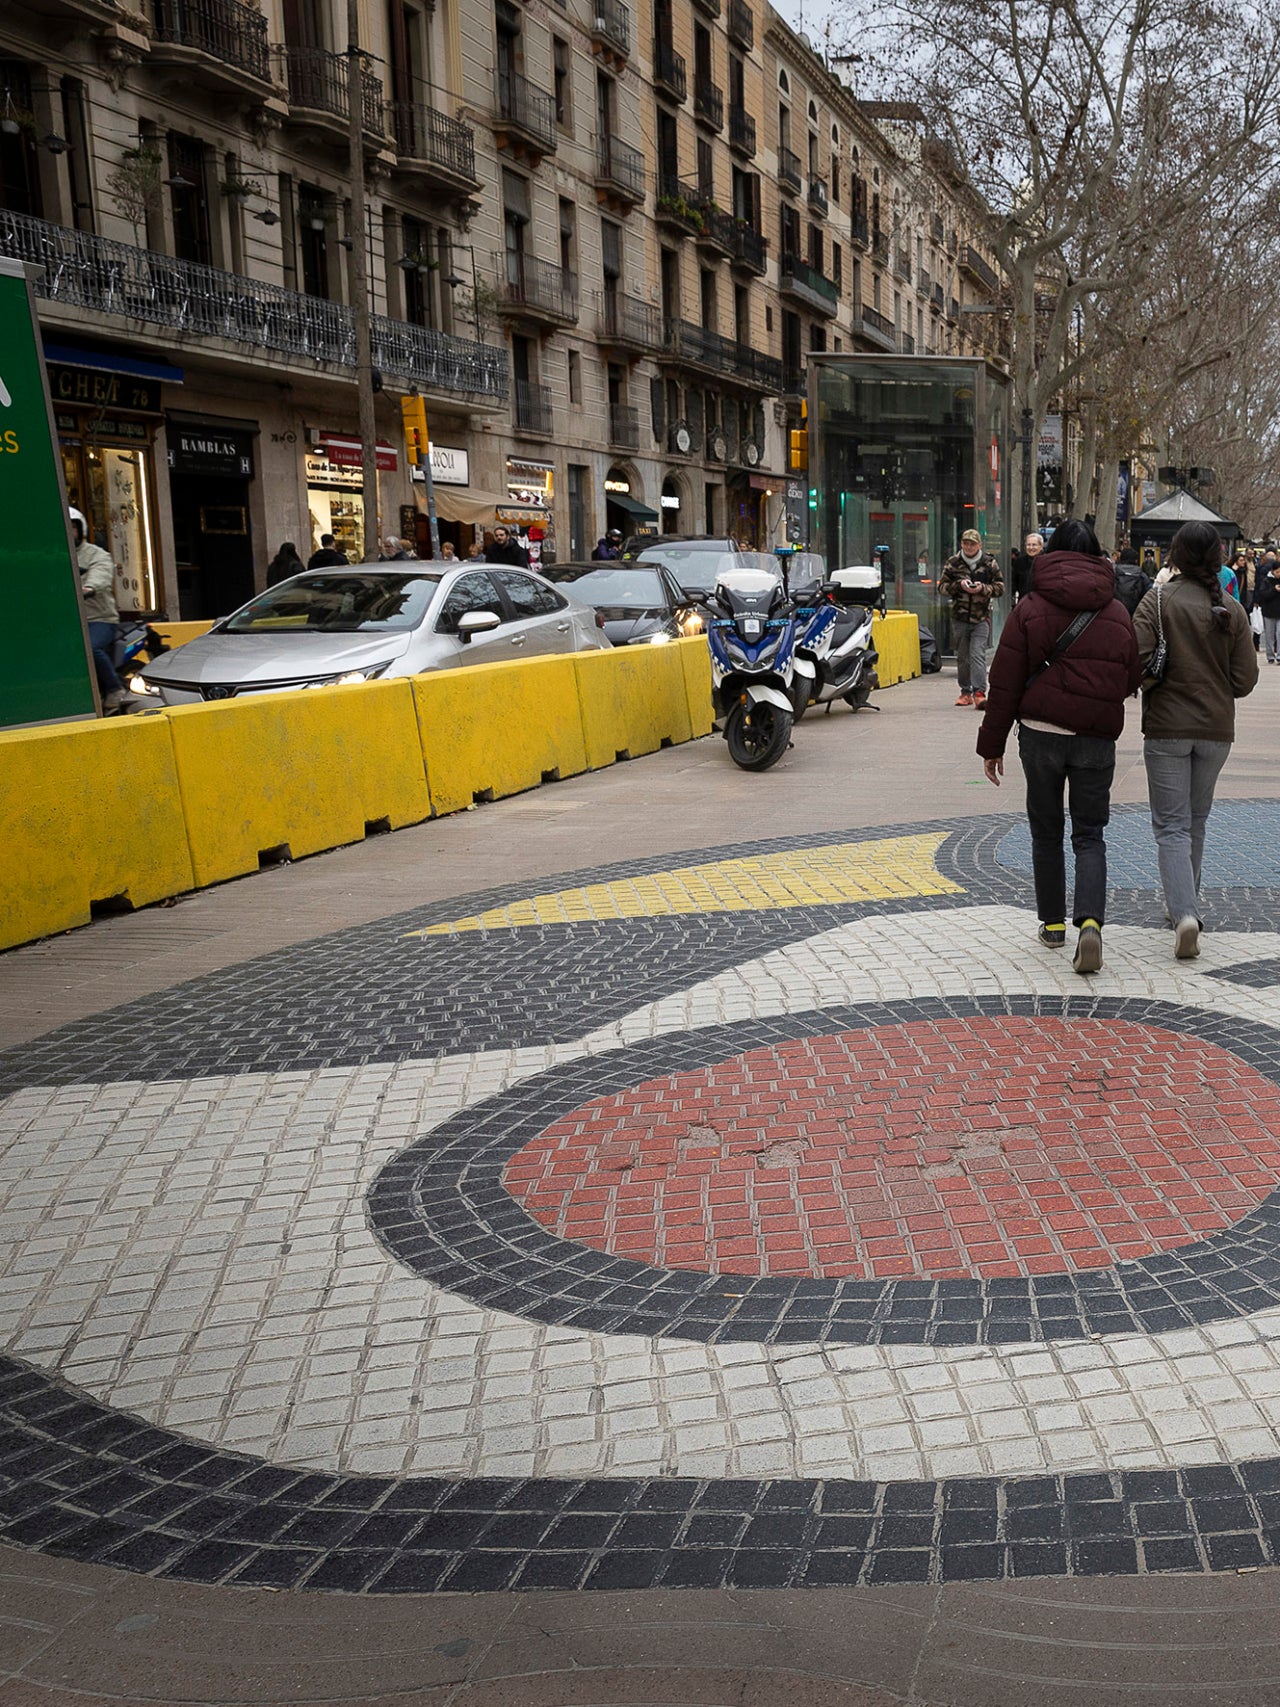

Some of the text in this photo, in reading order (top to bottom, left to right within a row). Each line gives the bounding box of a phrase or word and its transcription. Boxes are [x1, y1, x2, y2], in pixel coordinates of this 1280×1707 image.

[131, 388, 149, 407] 78
[181, 438, 236, 455] RAMBLAS
[241, 458, 250, 473] H
[639, 527, 652, 535] TAXI
